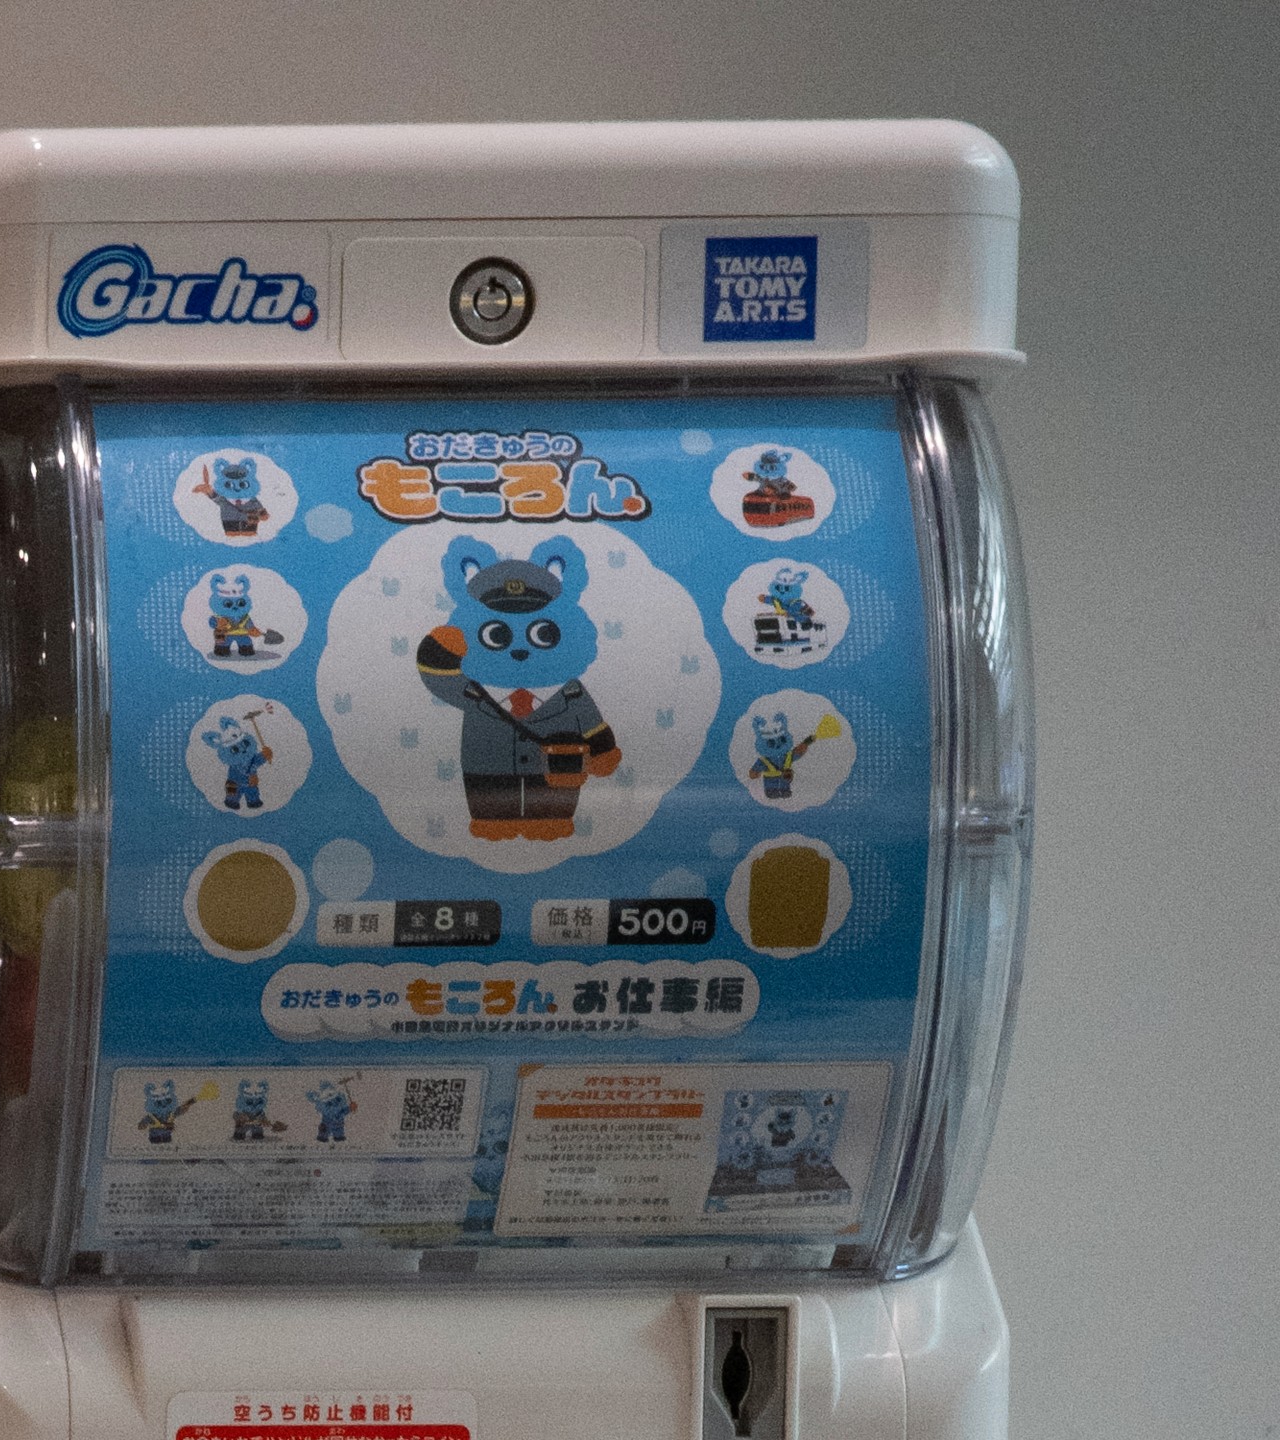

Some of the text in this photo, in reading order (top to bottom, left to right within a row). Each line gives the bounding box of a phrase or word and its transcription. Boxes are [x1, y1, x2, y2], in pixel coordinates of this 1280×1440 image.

[715, 256, 806, 275] TAKARA
[715, 277, 806, 298] TOMY
[406, 434, 576, 460] おだきゅうの
[333, 913, 380, 934] 種類
[548, 906, 594, 928] 価格
[618, 908, 707, 936] 500円
[280, 989, 398, 1010] おだきゅうの
[573, 978, 745, 1014] お仕事編
